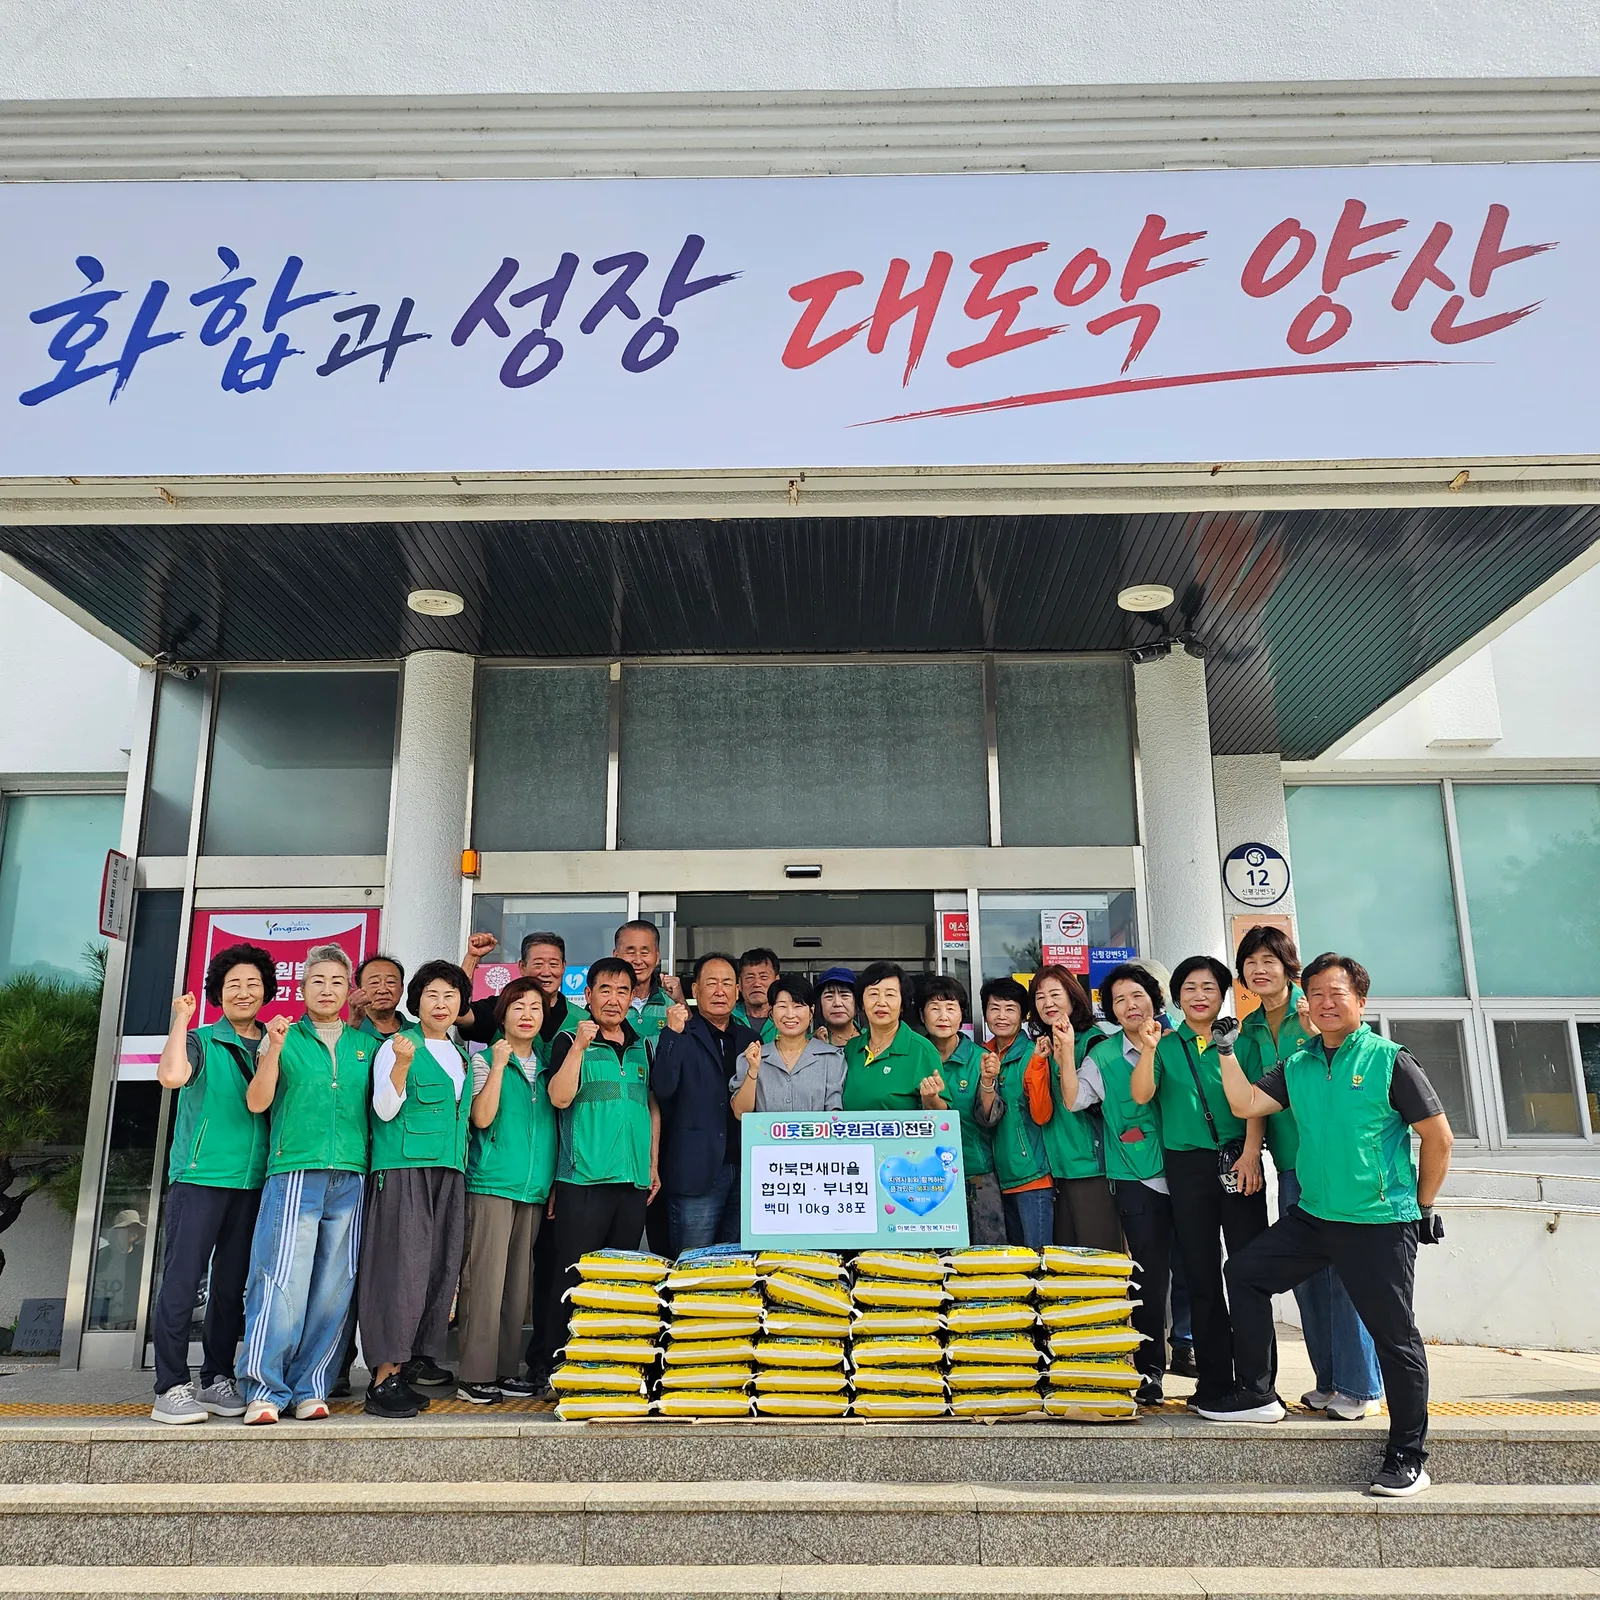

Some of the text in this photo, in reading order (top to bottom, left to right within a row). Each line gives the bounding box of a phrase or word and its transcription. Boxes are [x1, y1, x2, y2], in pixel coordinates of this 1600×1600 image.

[19, 198, 1561, 406] 화합과 성장 대도약 양산
[1246, 869, 1270, 886] 12
[1242, 888, 1276, 896] 신평강변5길
[265, 919, 311, 936] Yangsan
[1049, 946, 1082, 956] 금연시설
[1091, 950, 1128, 959] 신평강변5길
[771, 1121, 934, 1139] 이웃돕기 후원금(품) 전달
[768, 1161, 860, 1176] 하북면새마을
[761, 1181, 869, 1197] 협의회 부녀회
[764, 1202, 866, 1216] 백미 10kg 38포
